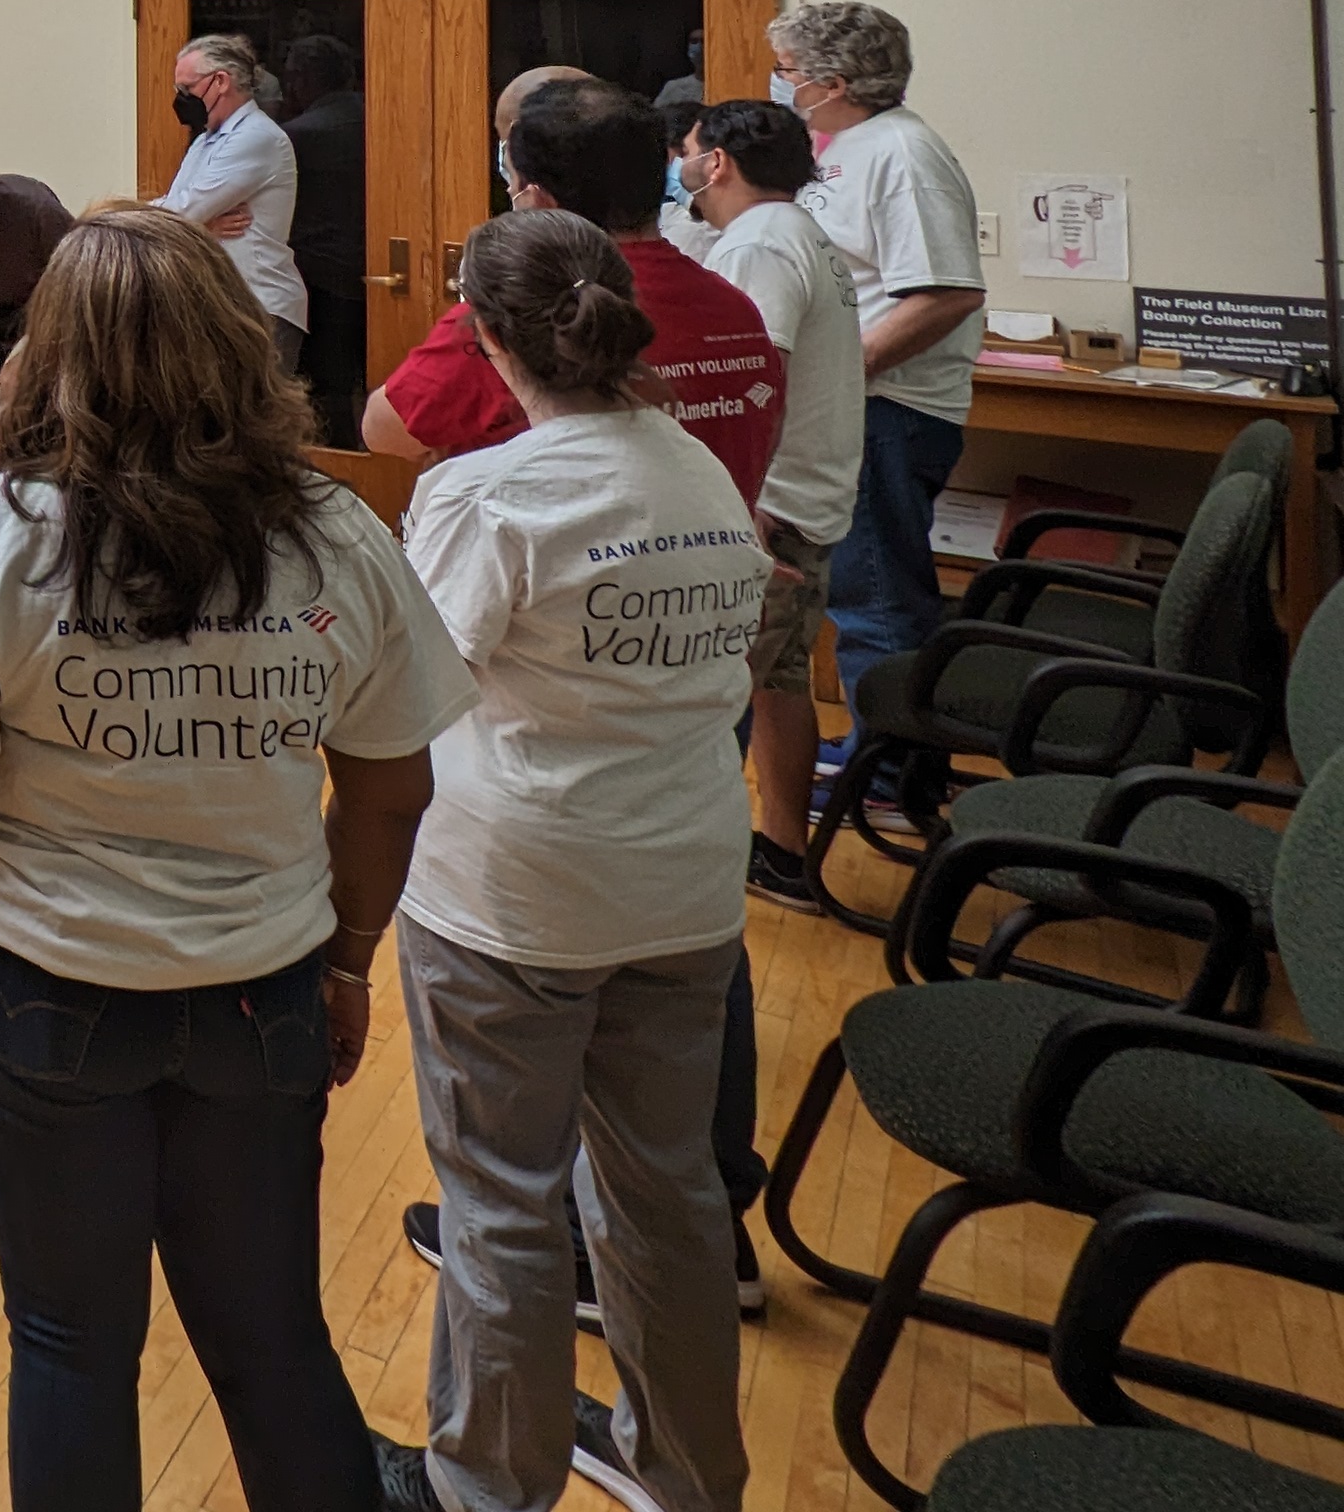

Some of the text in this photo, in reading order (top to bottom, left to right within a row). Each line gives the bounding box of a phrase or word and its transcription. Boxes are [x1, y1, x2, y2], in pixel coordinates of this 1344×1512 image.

[1141, 295, 1172, 308] The
[1174, 298, 1213, 311] Field
[1216, 301, 1285, 316] Museum
[1142, 310, 1282, 330] Botany Collection
[654, 354, 766, 380] UNITY VOLUNTEER
[674, 395, 745, 421] America
[587, 539, 650, 562] BANK
[654, 535, 678, 552] OF
[585, 568, 767, 620] Communit
[57, 616, 129, 636] BANK
[193, 615, 293, 634] MERICA
[582, 618, 761, 667] Voluntee
[54, 655, 340, 706] Community
[57, 703, 328, 761] Volunteer
